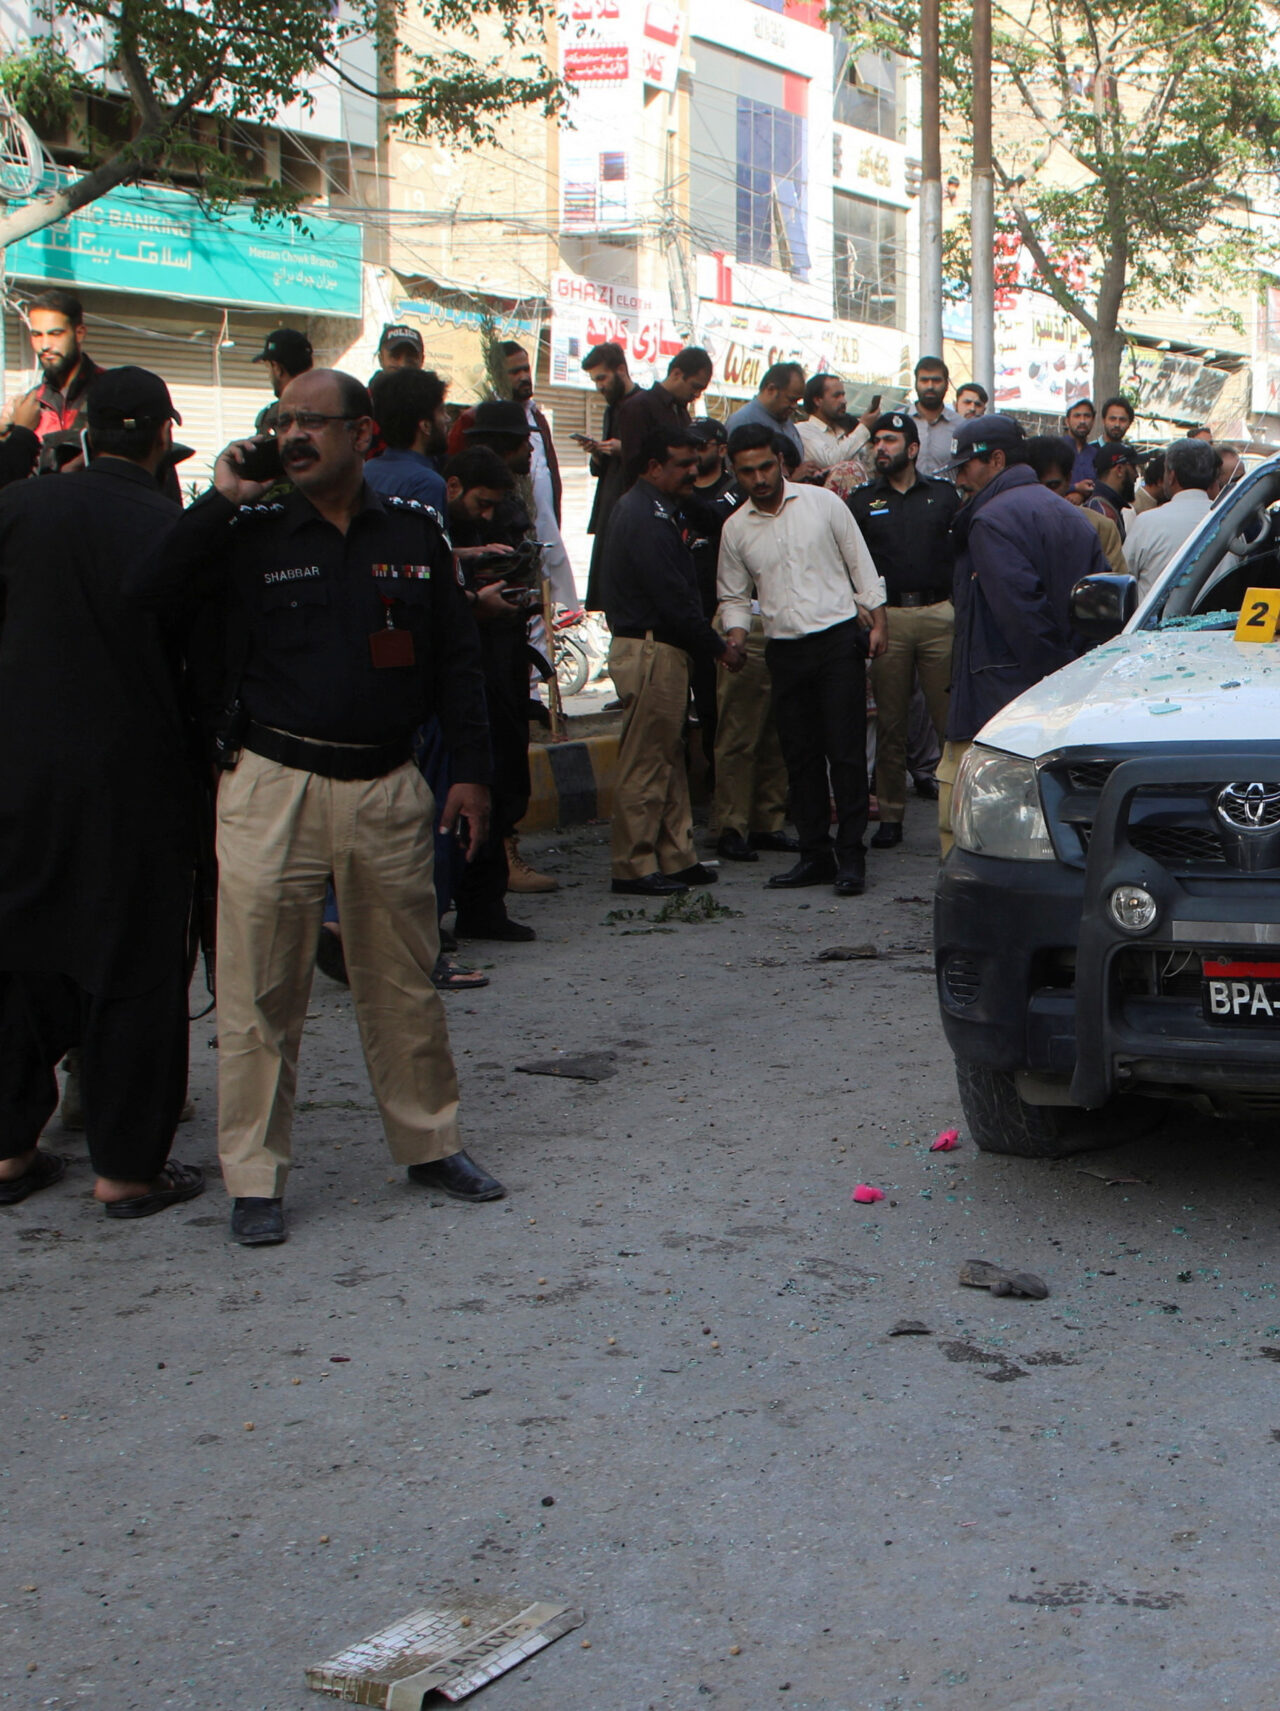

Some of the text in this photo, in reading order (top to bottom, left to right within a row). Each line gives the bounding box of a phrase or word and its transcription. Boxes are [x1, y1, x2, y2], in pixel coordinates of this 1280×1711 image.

[108, 208, 191, 238] BANKING
[558, 278, 613, 306] GHAZI
[387, 327, 419, 341] POLICE
[264, 566, 320, 584] SHABBAR
[1246, 602, 1270, 627] 2
